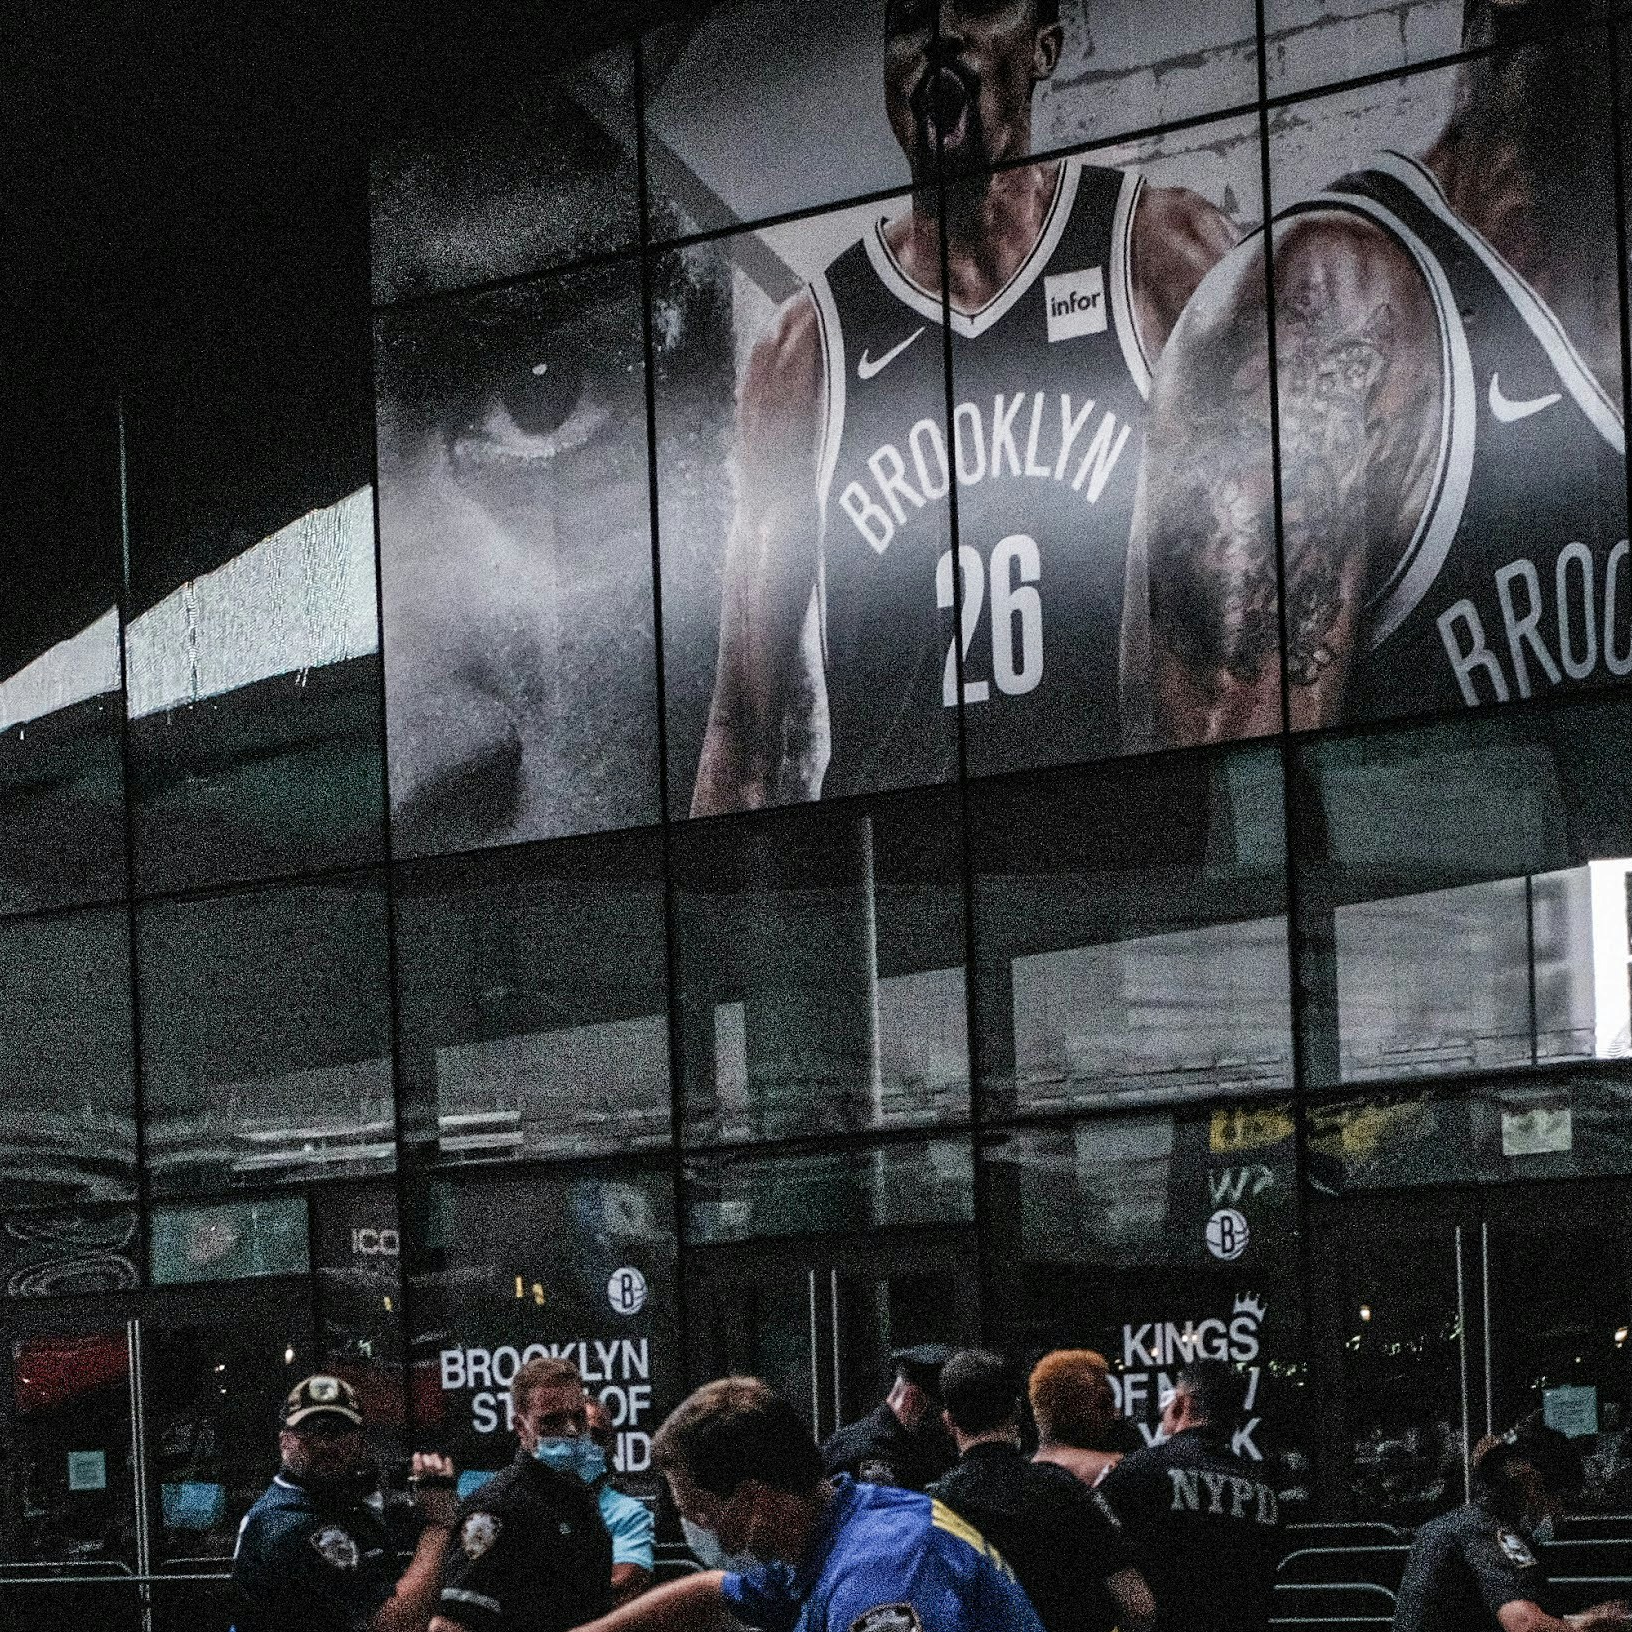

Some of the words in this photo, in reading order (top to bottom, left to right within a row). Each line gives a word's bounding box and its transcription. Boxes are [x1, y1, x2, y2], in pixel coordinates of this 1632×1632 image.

[1050, 290, 1101, 318] infor
[839, 391, 1132, 555] BROOKLYN
[935, 533, 1045, 708] 26
[1122, 1316, 1261, 1368] KINGS
[1168, 1467, 1279, 1525] NYPD
